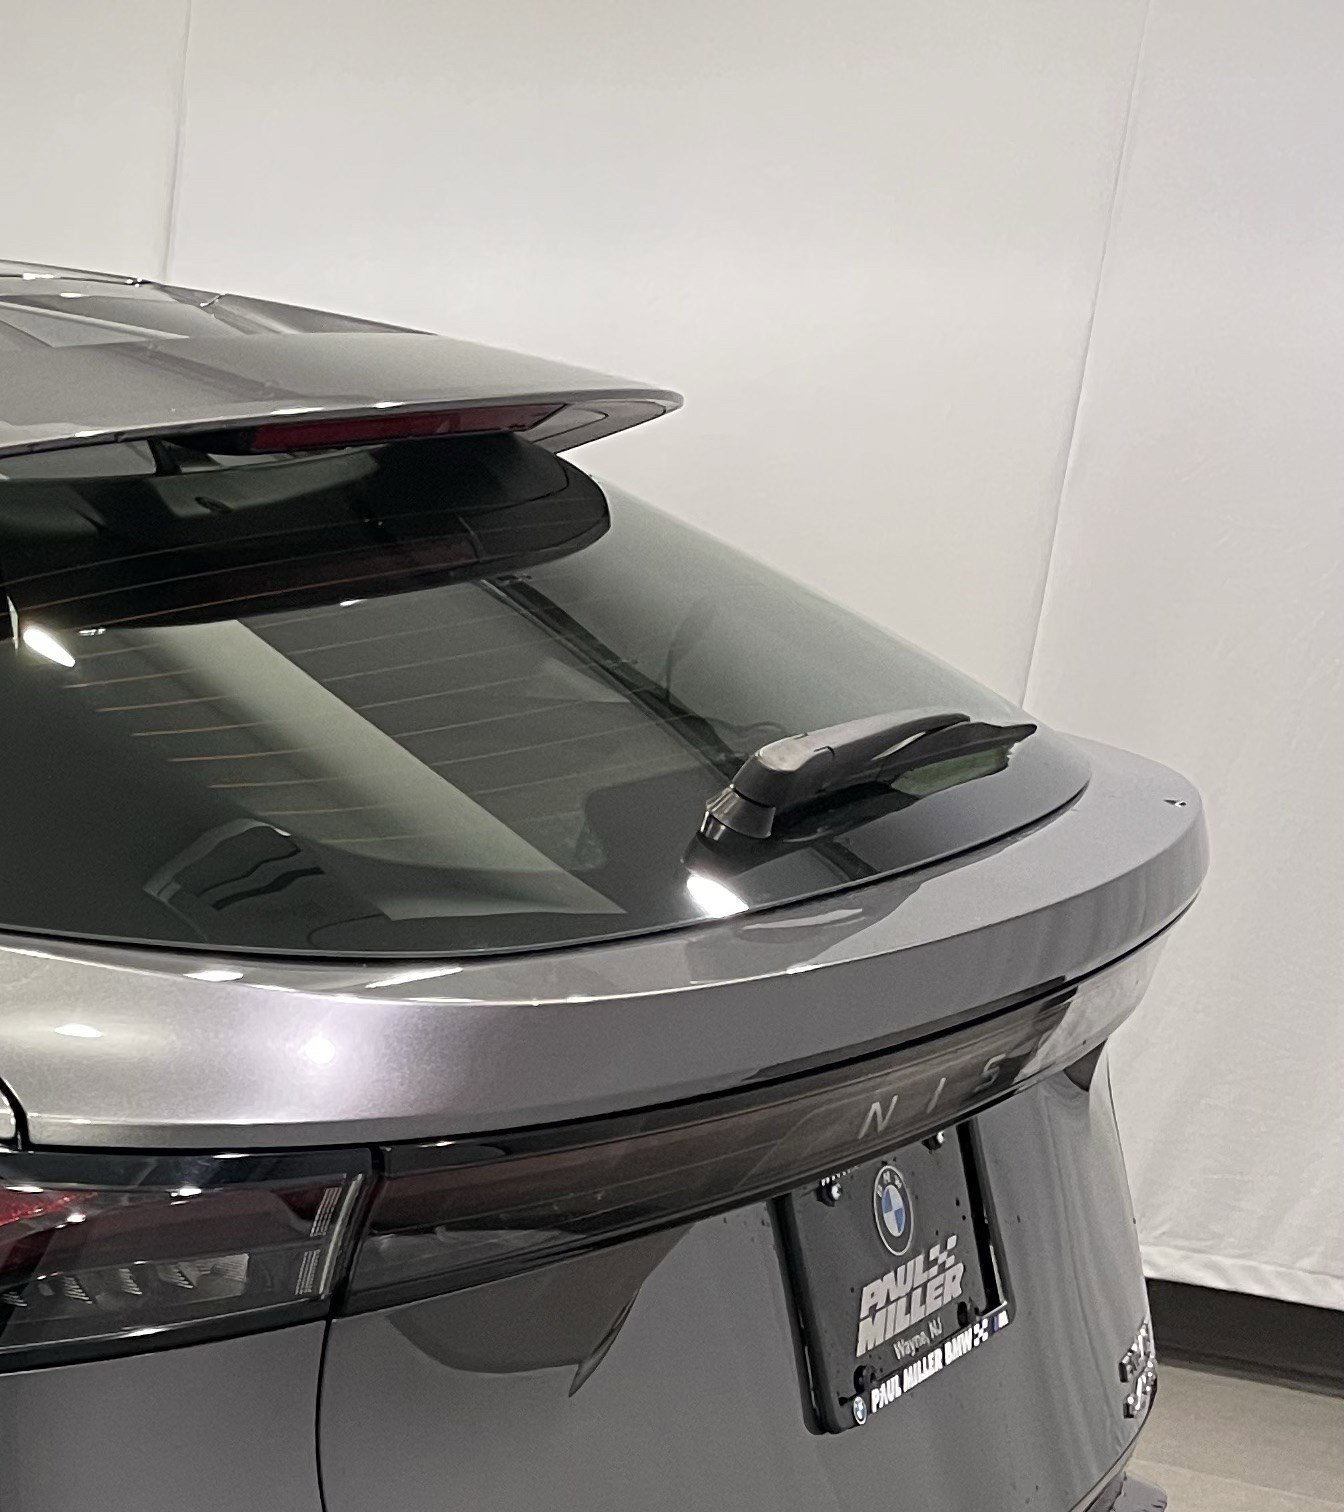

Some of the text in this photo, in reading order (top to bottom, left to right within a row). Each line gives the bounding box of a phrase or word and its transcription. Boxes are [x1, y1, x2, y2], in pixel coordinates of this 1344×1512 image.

[856, 1262, 964, 1358] MILLER
[860, 1254, 939, 1320] PAUL
[928, 1316, 943, 1339] NJ
[870, 1374, 902, 1414] PAUL
[903, 1348, 944, 1393] MILLER
[944, 1327, 973, 1366] BMW
